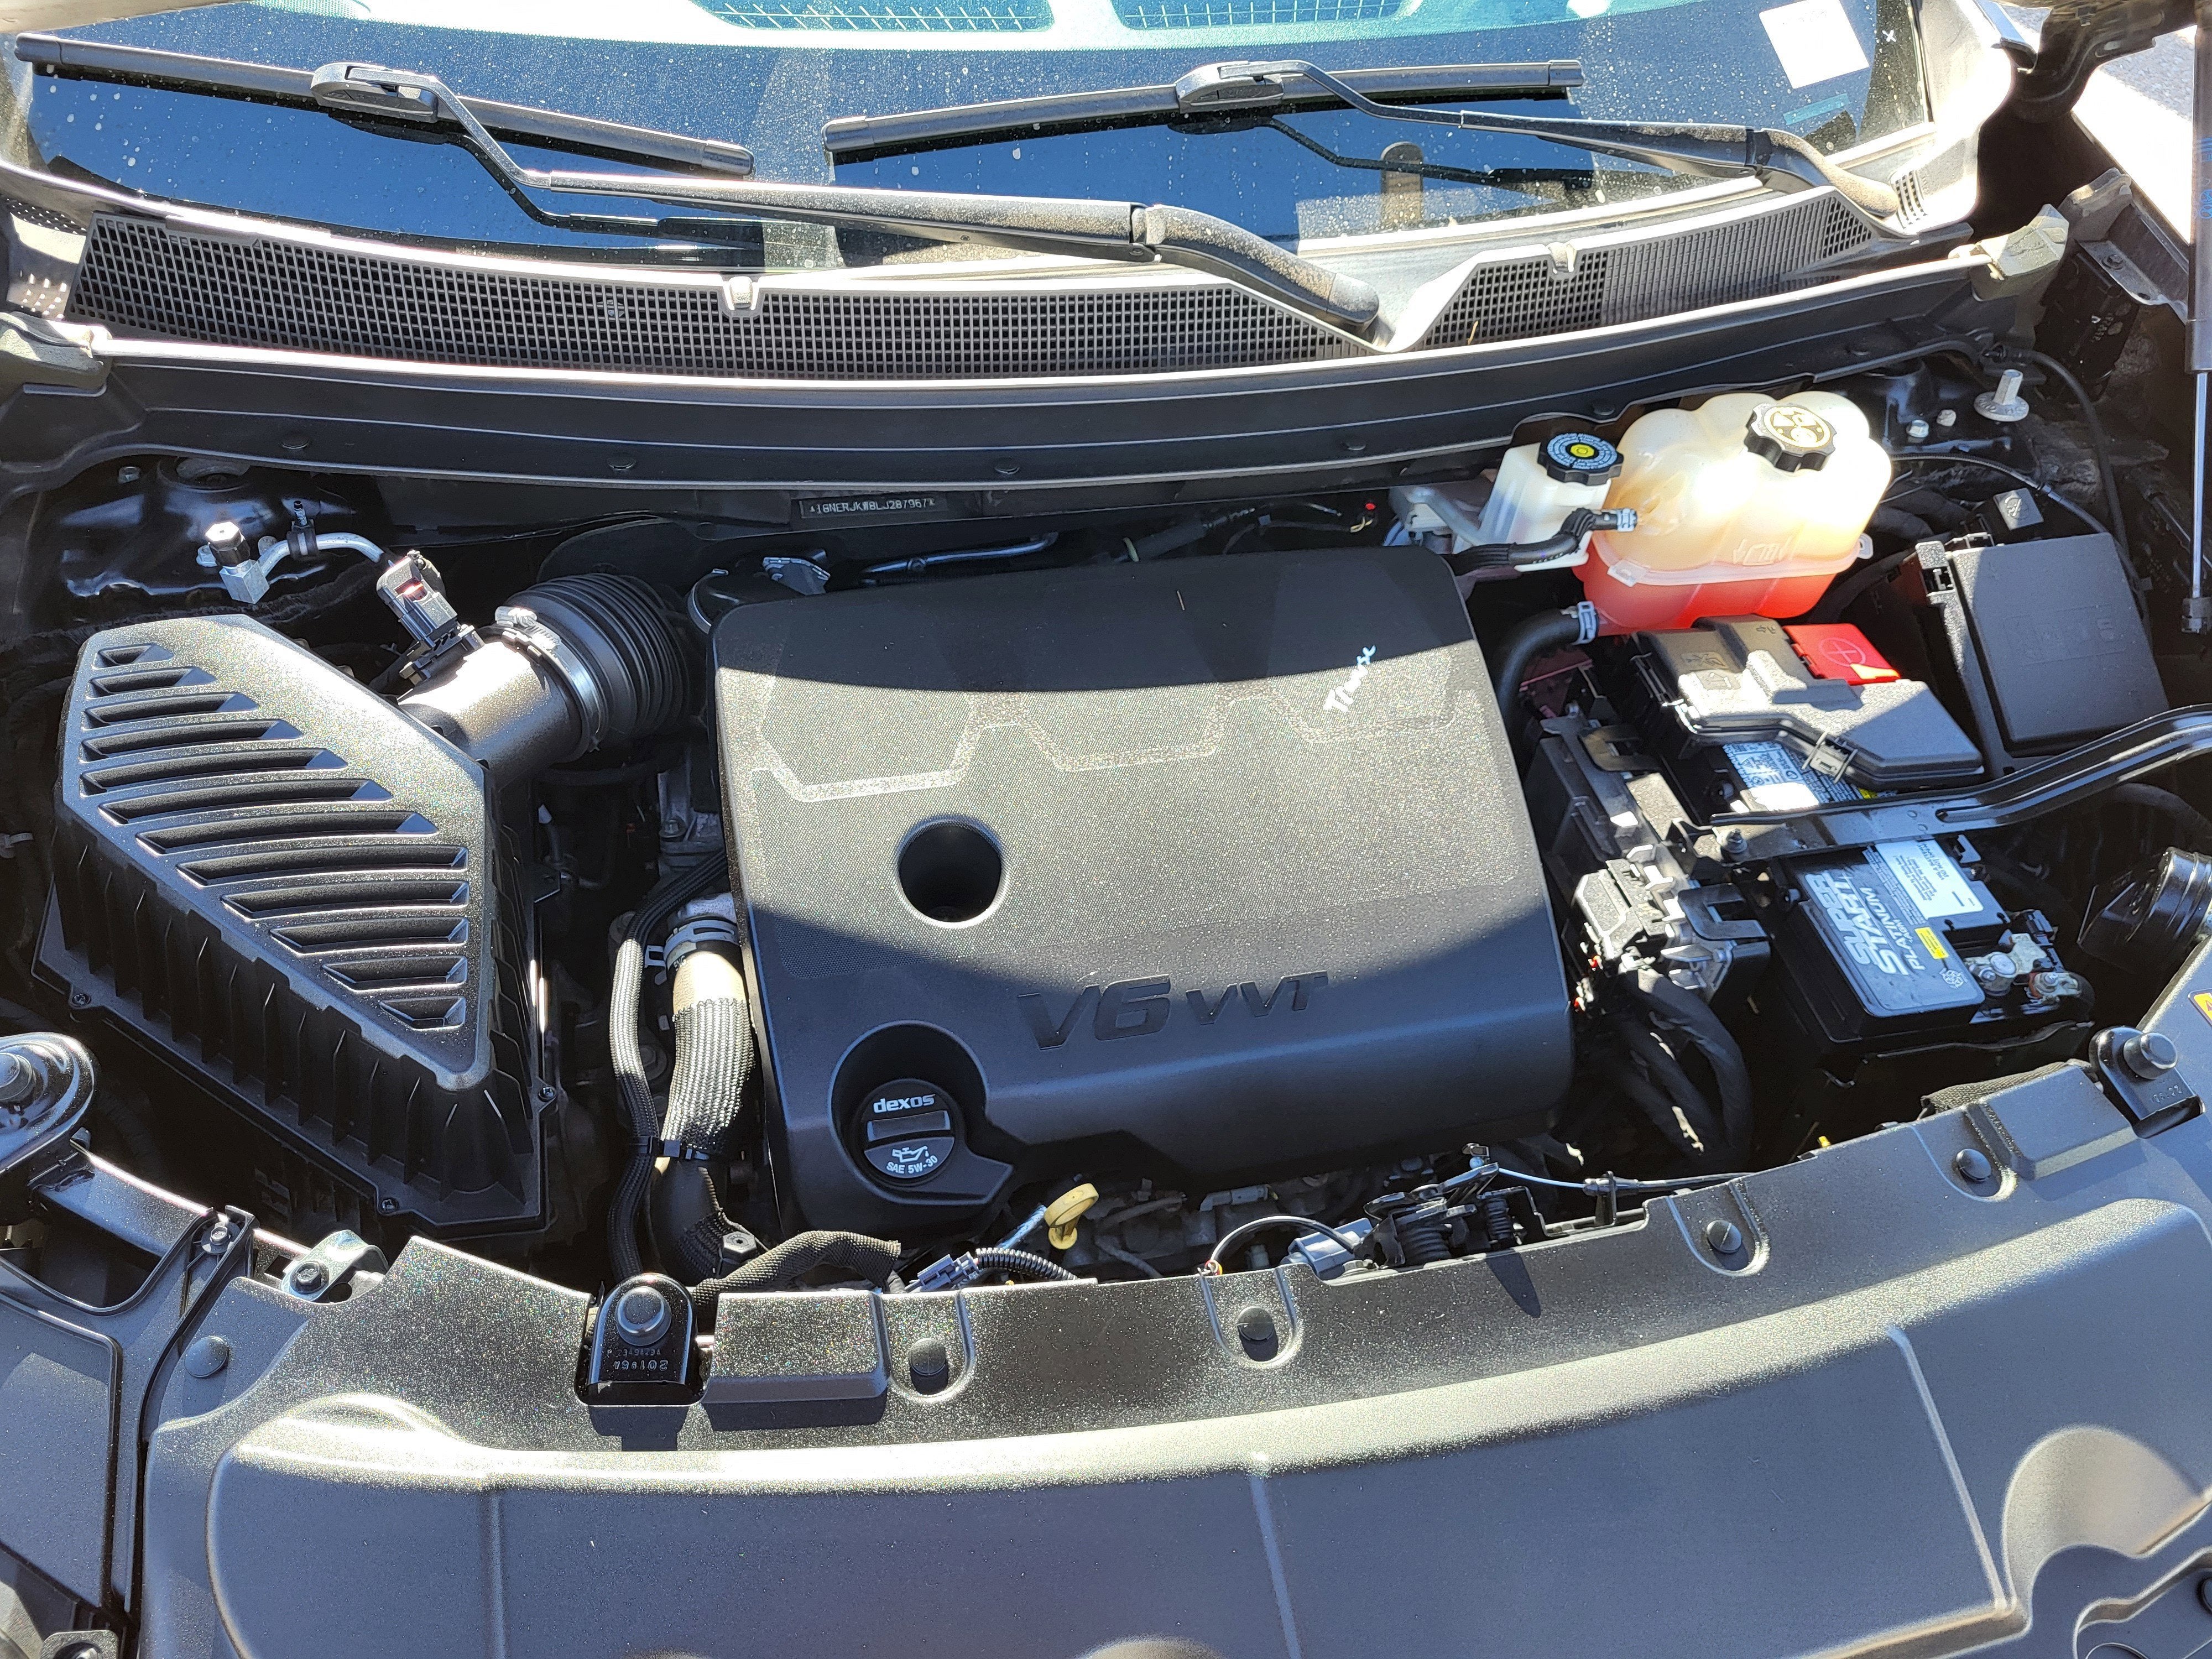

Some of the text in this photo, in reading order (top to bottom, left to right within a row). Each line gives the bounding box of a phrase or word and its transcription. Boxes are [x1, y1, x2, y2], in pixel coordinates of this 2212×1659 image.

[1804, 873, 1871, 964] SUPER
[1826, 868, 1910, 975] START
[1858, 886, 1927, 971] PLATINUM
[1018, 970, 1328, 1050] V6 VVT
[873, 1093, 936, 1114] dexos
[886, 1155, 938, 1174] SAE 5W-30
